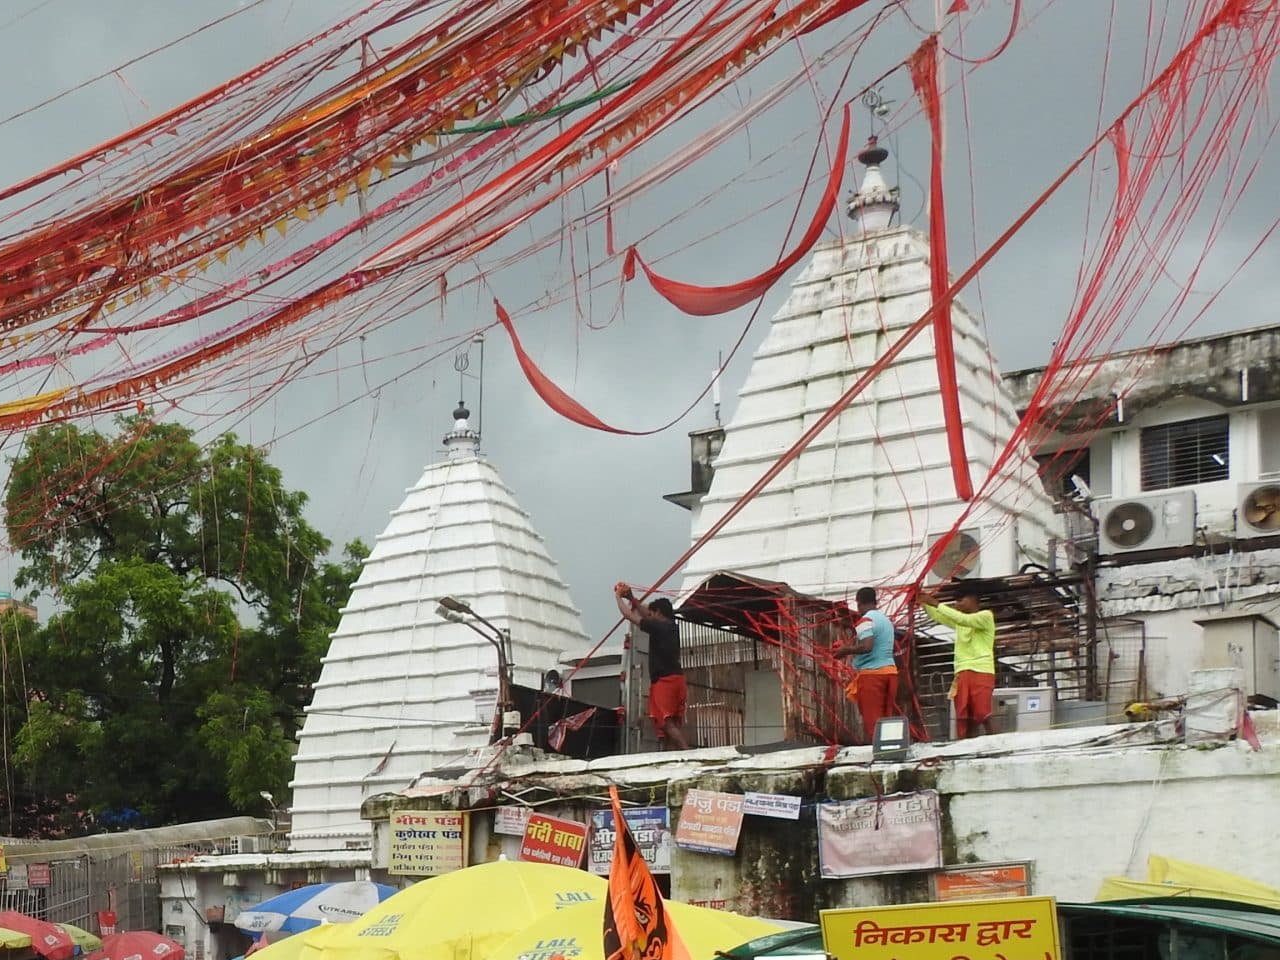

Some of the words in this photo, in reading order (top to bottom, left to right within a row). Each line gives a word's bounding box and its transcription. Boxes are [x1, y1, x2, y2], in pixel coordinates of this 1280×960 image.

[395, 814, 428, 825] भीम
[434, 814, 464, 826] पंडा
[527, 818, 554, 844] नंदी
[554, 829, 585, 852] बाबा
[554, 891, 596, 902] LALL
[853, 919, 971, 948] निकास
[976, 917, 1038, 947] द्वार
[535, 937, 577, 949] LALL
